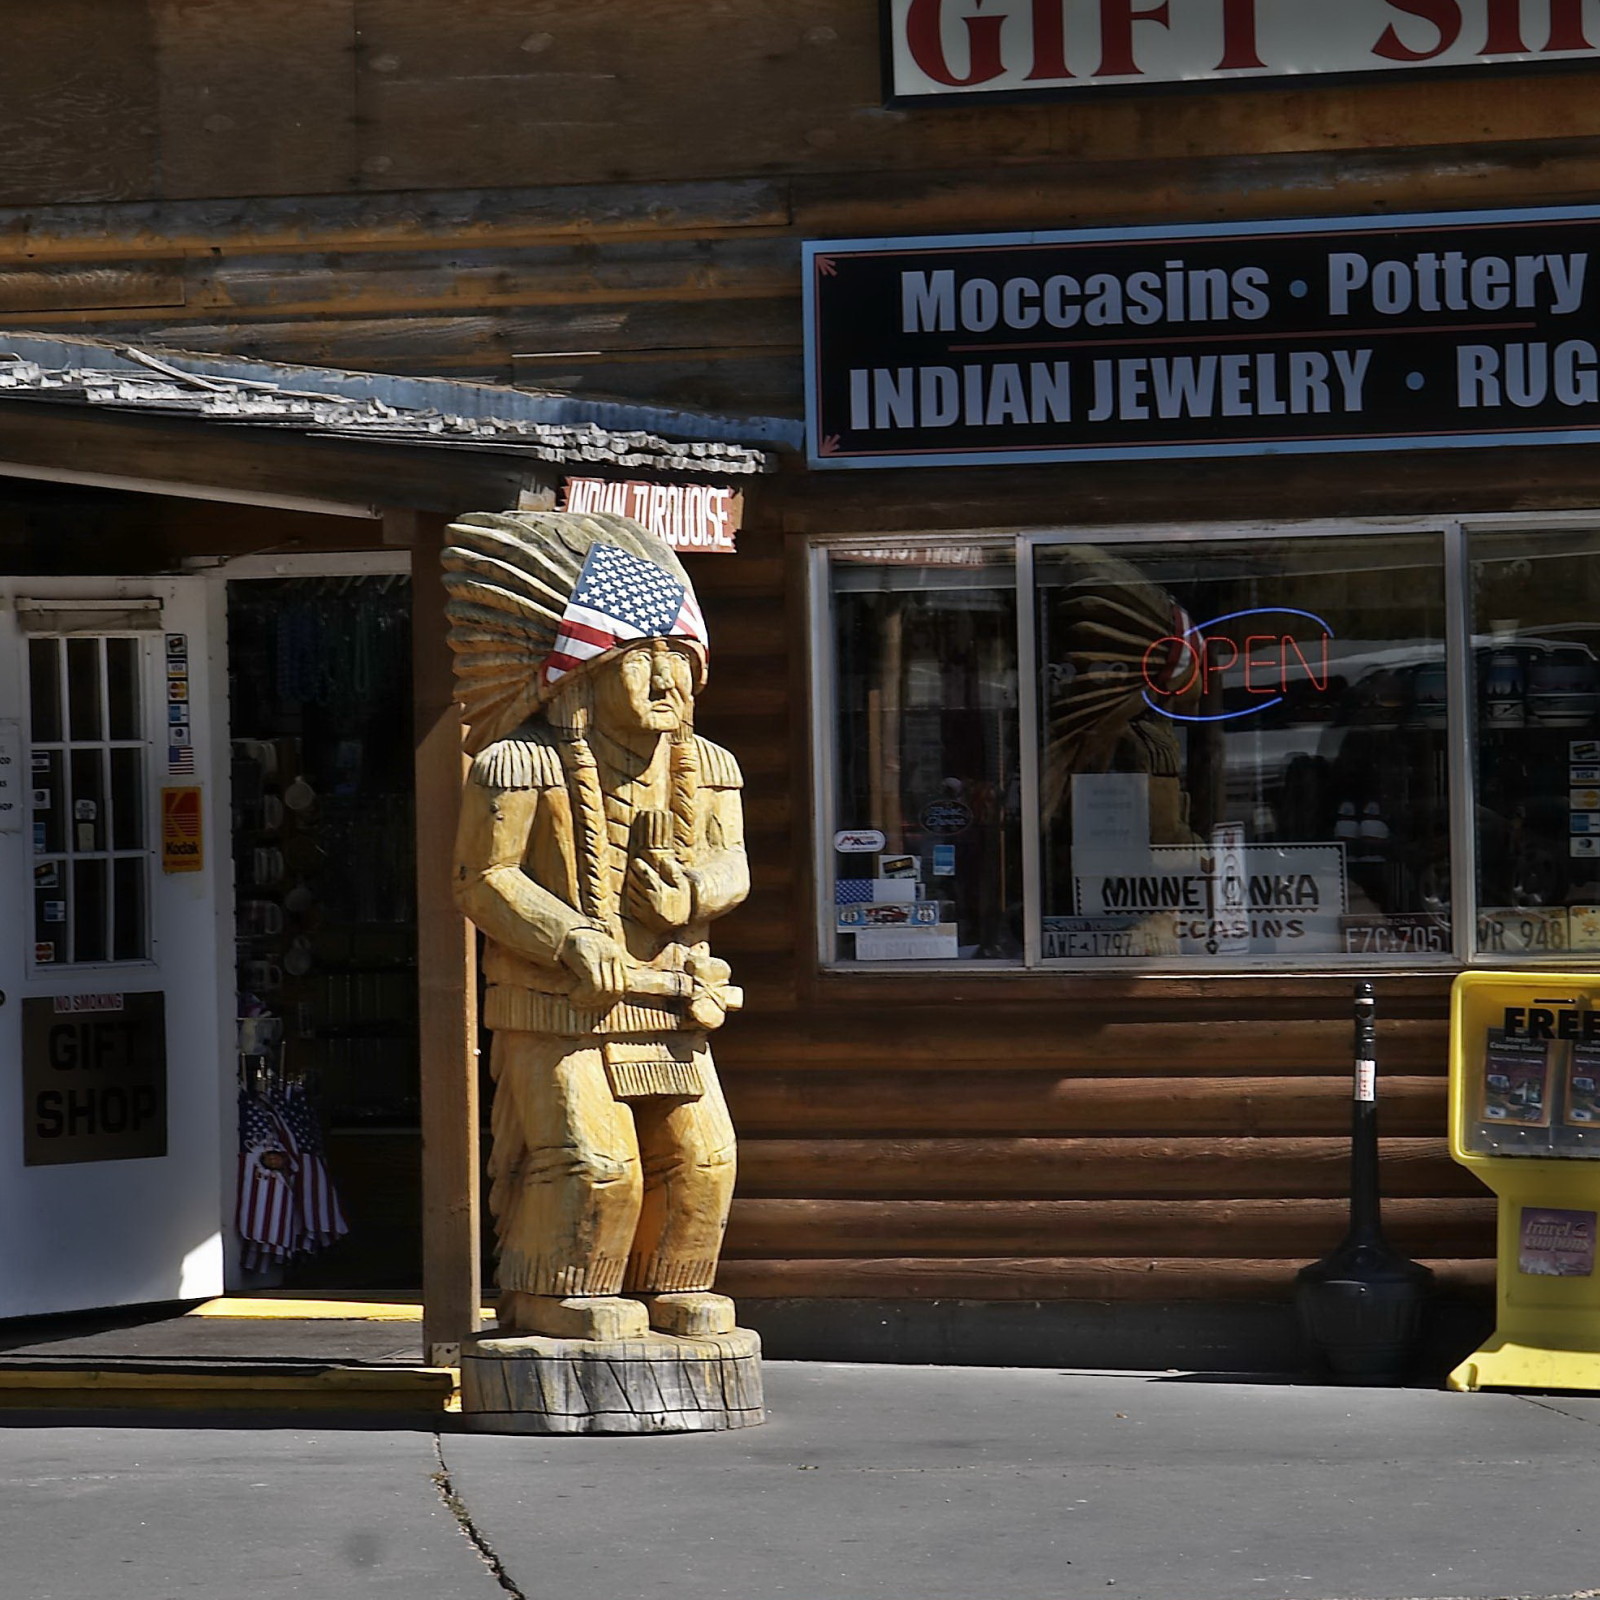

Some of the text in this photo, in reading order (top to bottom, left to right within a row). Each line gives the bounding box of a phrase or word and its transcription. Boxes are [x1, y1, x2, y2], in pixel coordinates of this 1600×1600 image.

[900, 251, 1589, 334] Moccasins Pottery
[848, 361, 1072, 431] INDIAN
[1087, 348, 1374, 422] JEWELRY
[567, 479, 733, 549] INDIAN TURQUOISE
[1141, 632, 1329, 696] OPEN
[165, 841, 200, 855] Kodak
[1172, 920, 1305, 939] CCASINS
[55, 993, 122, 1011] NO SMOKING
[1504, 1007, 1600, 1040] FREE
[36, 1019, 157, 1138] GIFT SHOP
[1525, 1221, 1571, 1237] travel
